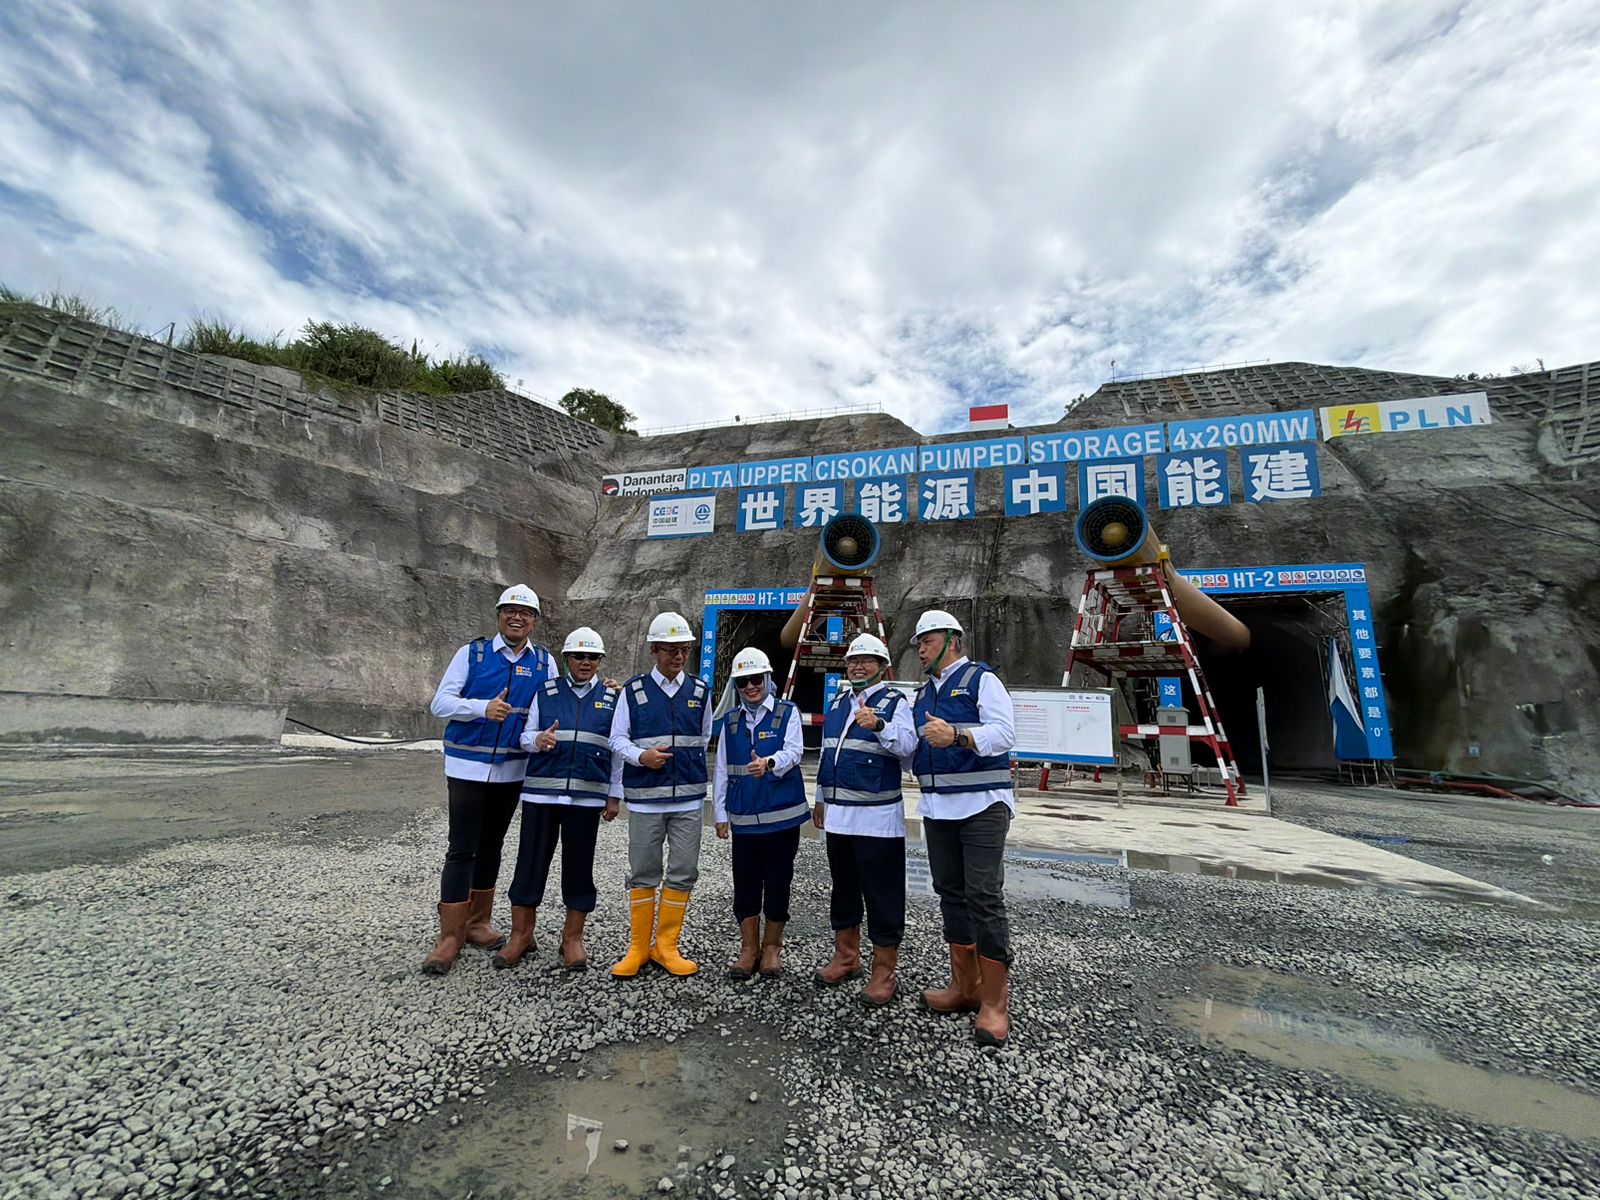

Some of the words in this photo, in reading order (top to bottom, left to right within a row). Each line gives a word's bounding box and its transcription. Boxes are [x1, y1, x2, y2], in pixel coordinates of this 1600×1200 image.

[1389, 405, 1473, 430] PLN
[690, 470, 733, 489] PLTA
[741, 463, 808, 486] UPPER
[816, 453, 916, 480] CISOKAN
[922, 443, 1023, 471] PUMPED
[1030, 431, 1160, 463] STORAGE
[1174, 416, 1309, 449] 4x260MW
[623, 473, 684, 486] Danantara
[1233, 571, 1275, 588] HT-2
[758, 592, 784, 605] HT-1
